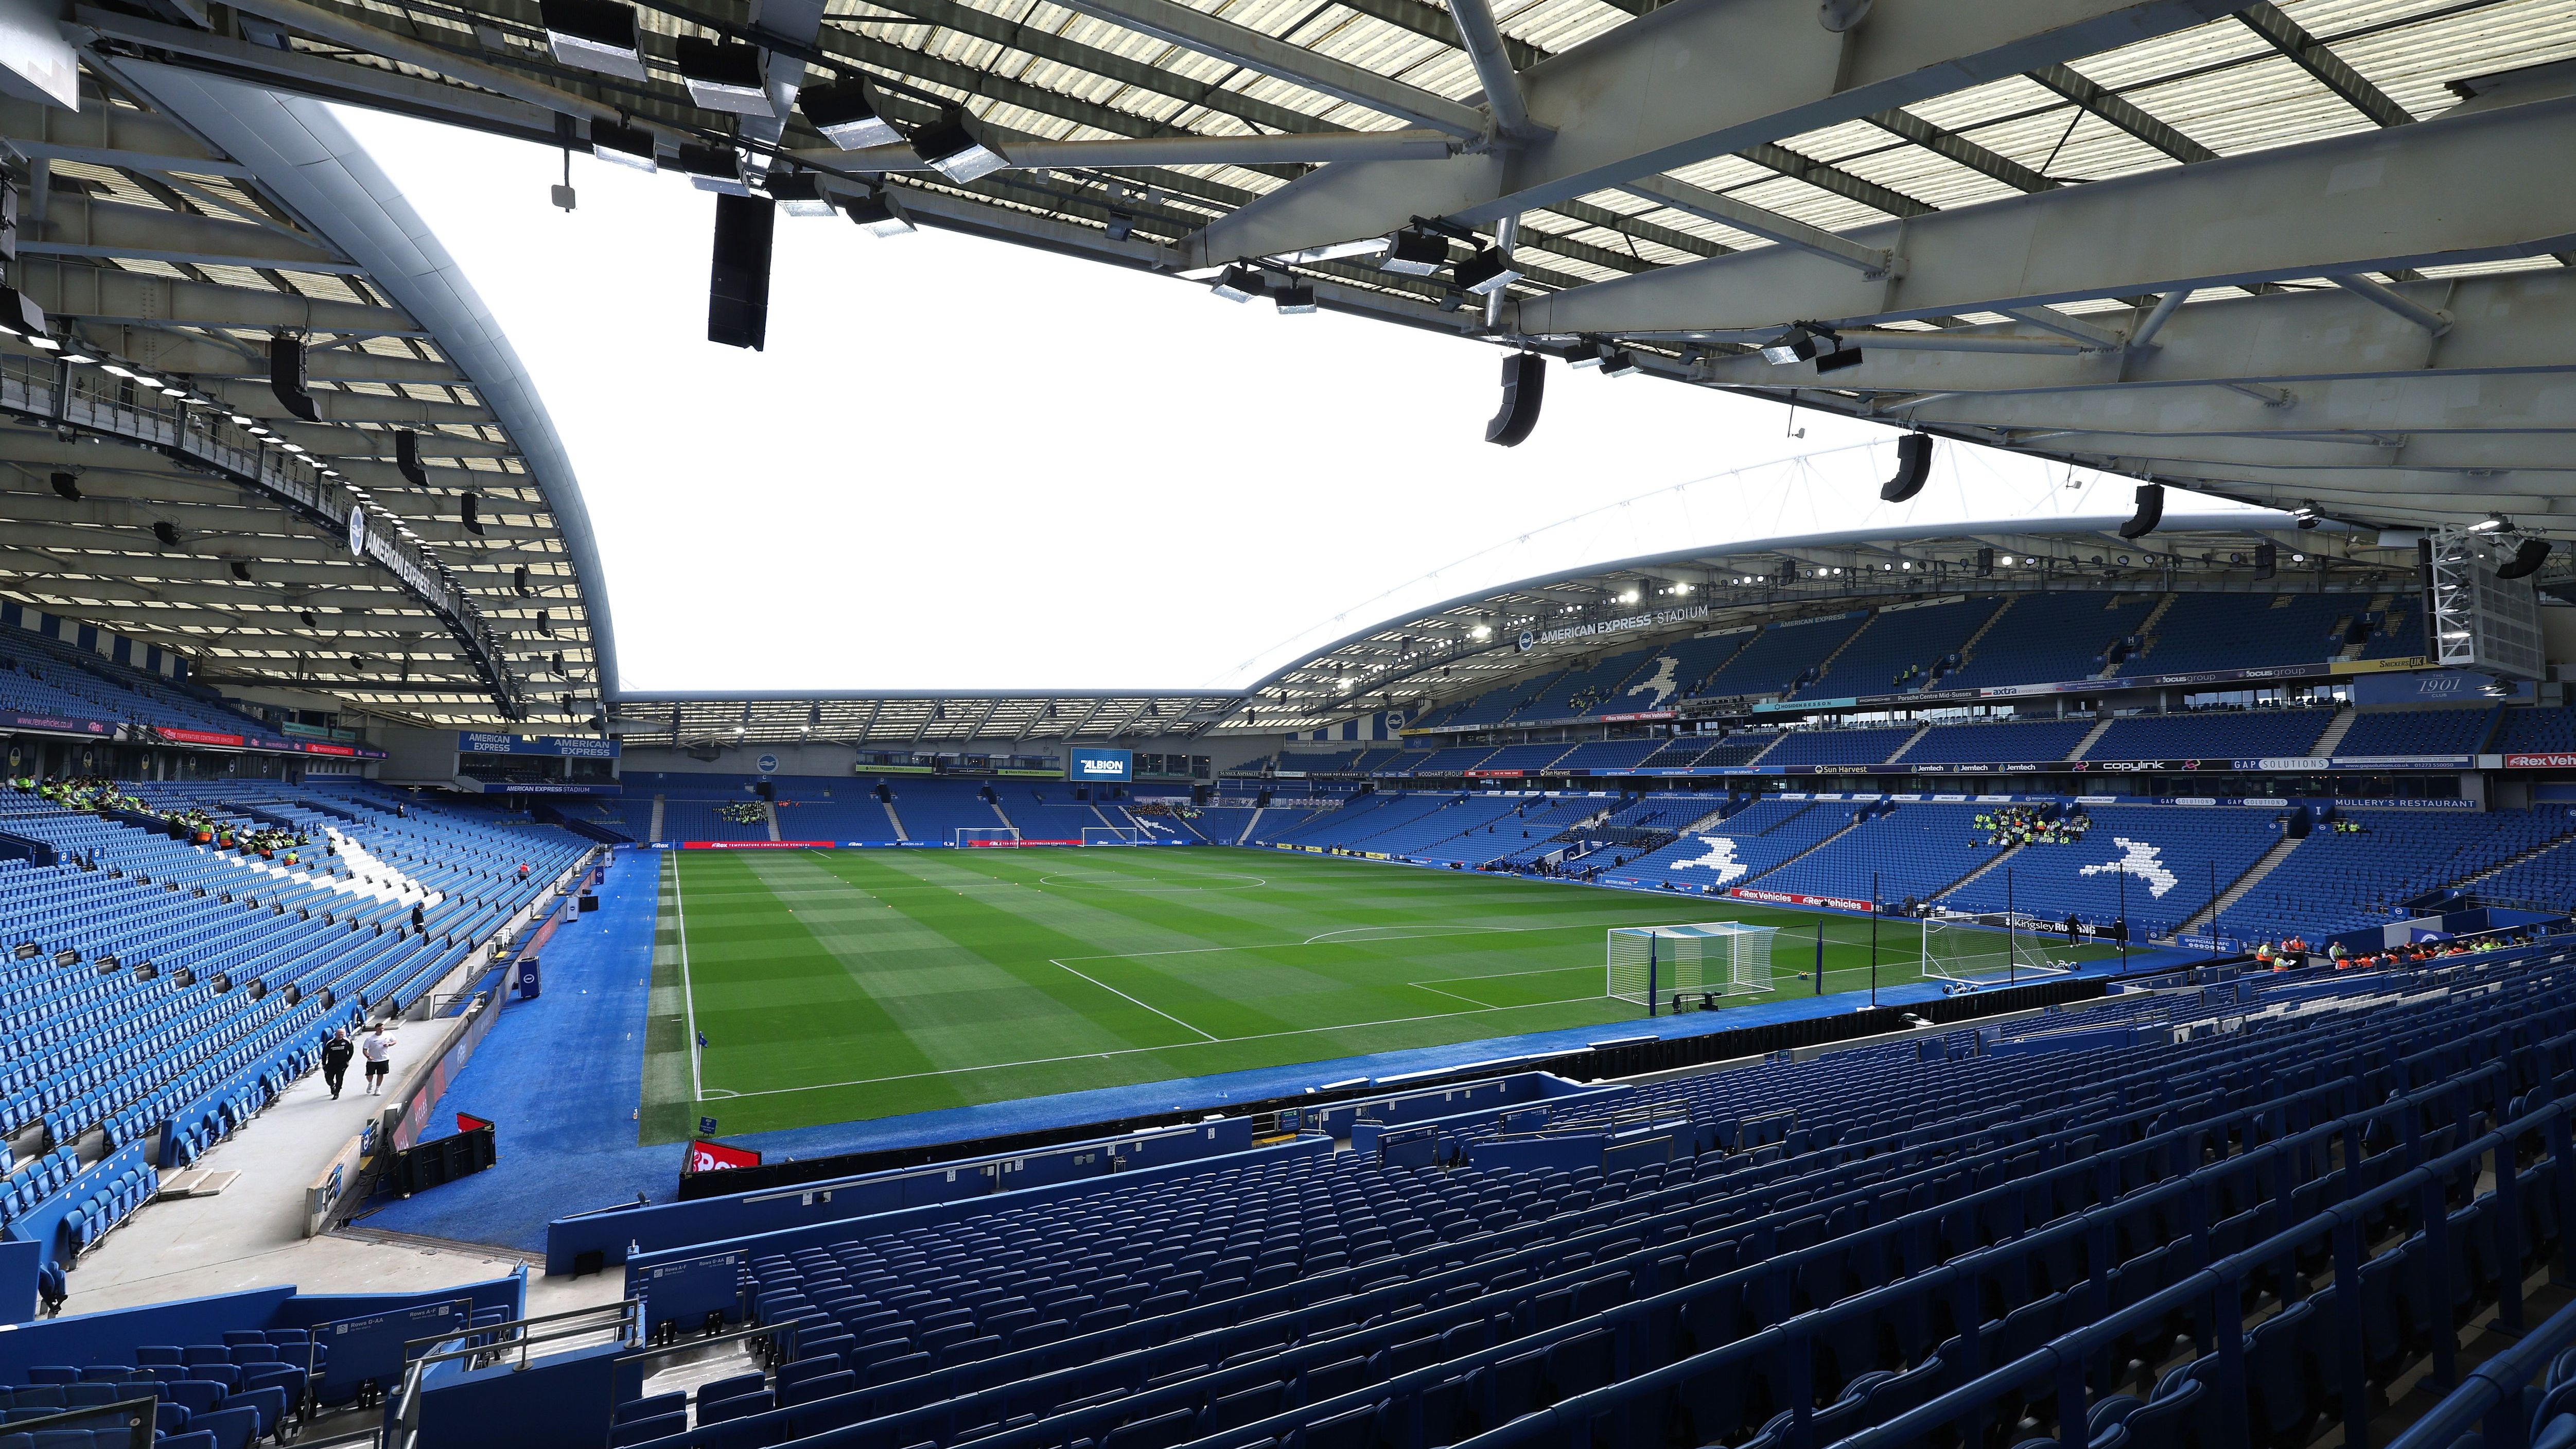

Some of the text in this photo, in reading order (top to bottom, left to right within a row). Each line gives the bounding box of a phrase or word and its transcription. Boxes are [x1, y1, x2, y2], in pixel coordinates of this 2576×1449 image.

[365, 530, 404, 577] AMERICAN
[404, 561, 430, 597] EXPRESS
[1540, 605, 1708, 642] AMERICAN EXPRESS STADIUM
[1780, 613, 1846, 629] AMERICAN EXPRESS
[2419, 678, 2461, 692] 1901
[1993, 687, 2017, 695] axtra
[17, 717, 73, 729] www.rexvehicles.co.uk
[469, 734, 510, 743] AMERICAN
[554, 739, 610, 748] AMERICAN
[474, 743, 510, 752] EXPRESS
[561, 747, 610, 756] EXPRESS
[2104, 761, 2165, 771] copylink
[2264, 760, 2324, 768] SOLUTIONS
[2520, 756, 2547, 765] Rex
[1745, 890, 1792, 902] Rex Vehicles
[1808, 897, 1862, 910] Rex Vehicles
[2014, 918, 2054, 932] Kingsley
